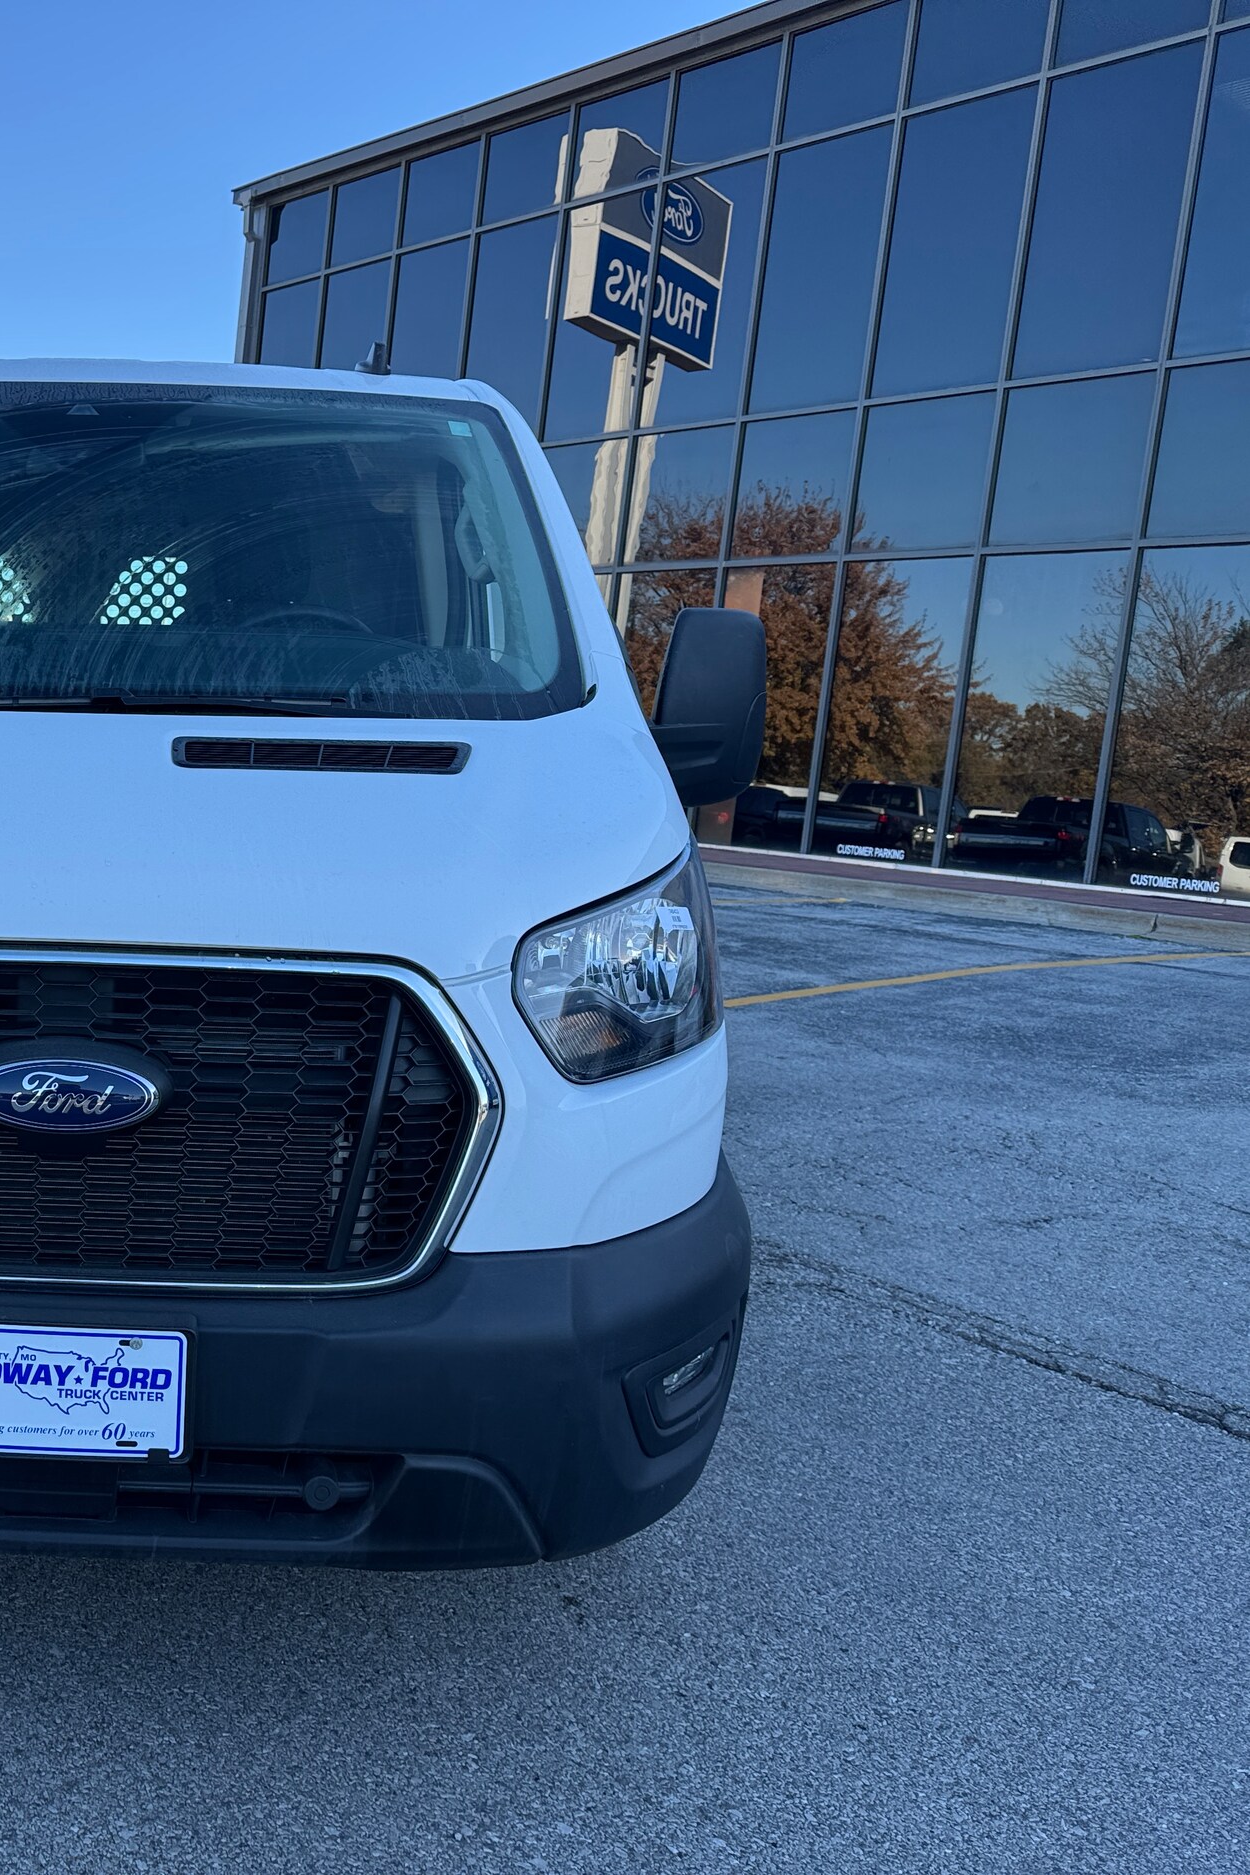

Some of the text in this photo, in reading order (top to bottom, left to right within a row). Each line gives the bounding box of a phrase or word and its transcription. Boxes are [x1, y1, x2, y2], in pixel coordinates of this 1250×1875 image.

[837, 844, 905, 860] CUSTOMER PARKING
[1130, 873, 1220, 893] CUSTOMER PARKING
[11, 1071, 114, 1114] Ford
[90, 1366, 172, 1390] FORD
[57, 1388, 164, 1402] TRUCK CENTER
[7, 1425, 57, 1435] customers
[58, 1426, 75, 1437] for
[101, 1422, 126, 1440] 60
[128, 1430, 155, 1439] years
